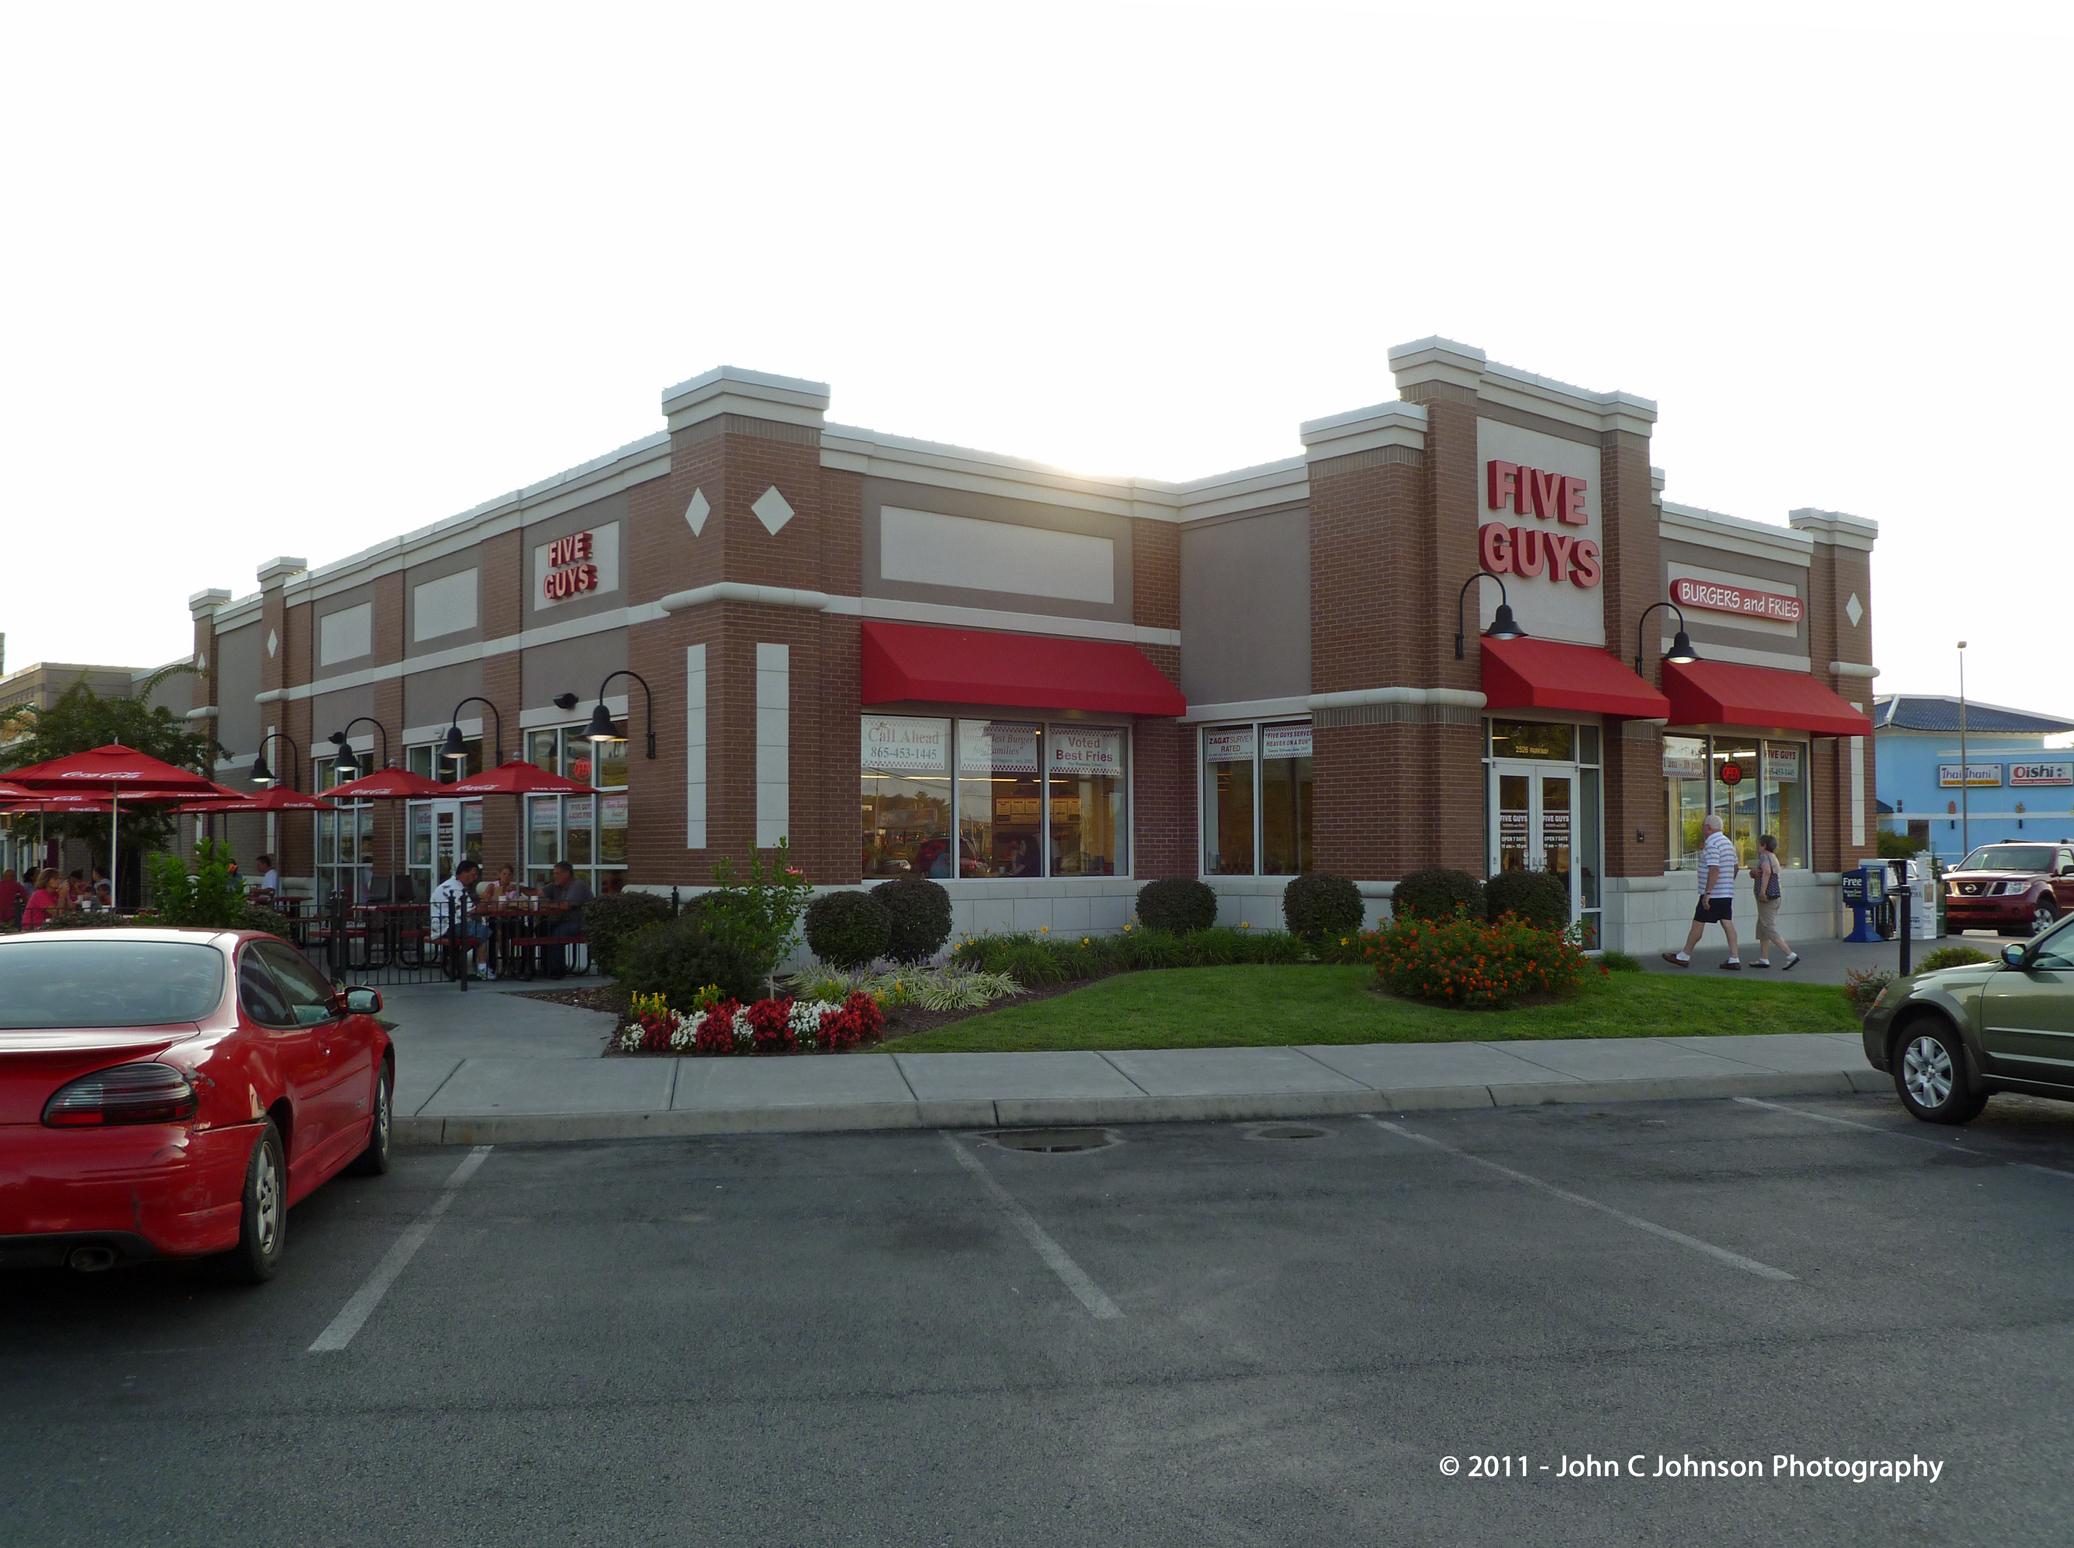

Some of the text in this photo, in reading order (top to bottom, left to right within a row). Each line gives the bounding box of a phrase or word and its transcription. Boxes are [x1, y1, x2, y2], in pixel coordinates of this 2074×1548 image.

[1486, 459, 1588, 525] FIVE
[548, 532, 593, 568] FIVE
[1479, 521, 1601, 588] GUYS
[543, 563, 598, 600] GUYS
[1682, 582, 1800, 618] BURGERS and FRIES
[868, 728, 940, 745] Call Ahead
[1007, 734, 1034, 746] Burger
[1068, 737, 1101, 748] Voted
[870, 746, 938, 760] 865-453-1445
[1056, 749, 1113, 762] Best Fries
[1220, 744, 1241, 753] RATED
[1780, 751, 1796, 760] GUYS
[1941, 767, 1991, 779] Thai Thani
[2013, 765, 2054, 779] Oishi
[1842, 877, 1862, 886] Free
